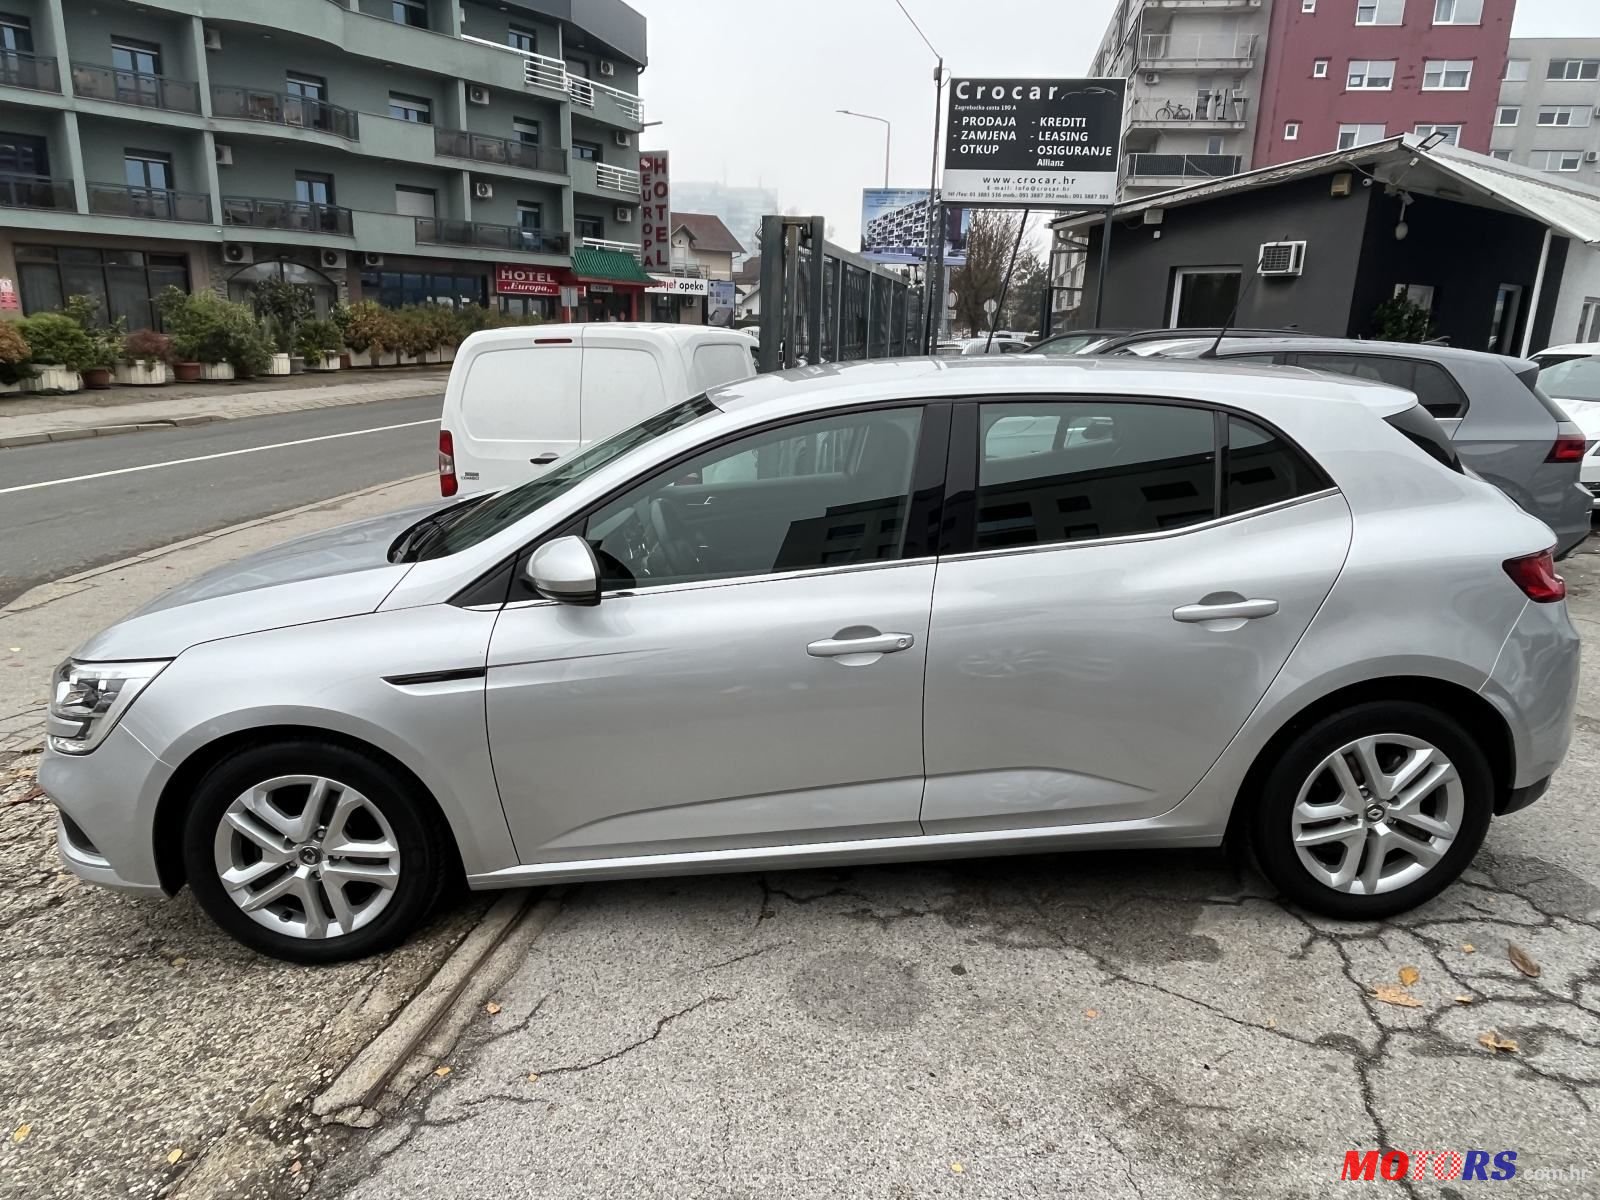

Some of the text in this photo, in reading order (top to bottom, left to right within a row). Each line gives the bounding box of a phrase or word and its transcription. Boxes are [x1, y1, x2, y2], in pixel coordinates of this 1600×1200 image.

[955, 80, 1058, 100] Crocar
[962, 116, 1017, 127] PRODAJA
[1039, 116, 1087, 128] KREDITI
[960, 130, 1017, 141] ZAMJENA
[1038, 131, 1089, 142] LEASING
[959, 144, 1000, 155] OTKUP
[1036, 145, 1113, 156] OSIGURANJE
[1036, 158, 1065, 167] Allianz
[982, 176, 1077, 185] www.crocar.hr
[653, 157, 668, 266] HOTEL
[501, 269, 556, 283] HOTEL
[679, 280, 704, 293] opeke
